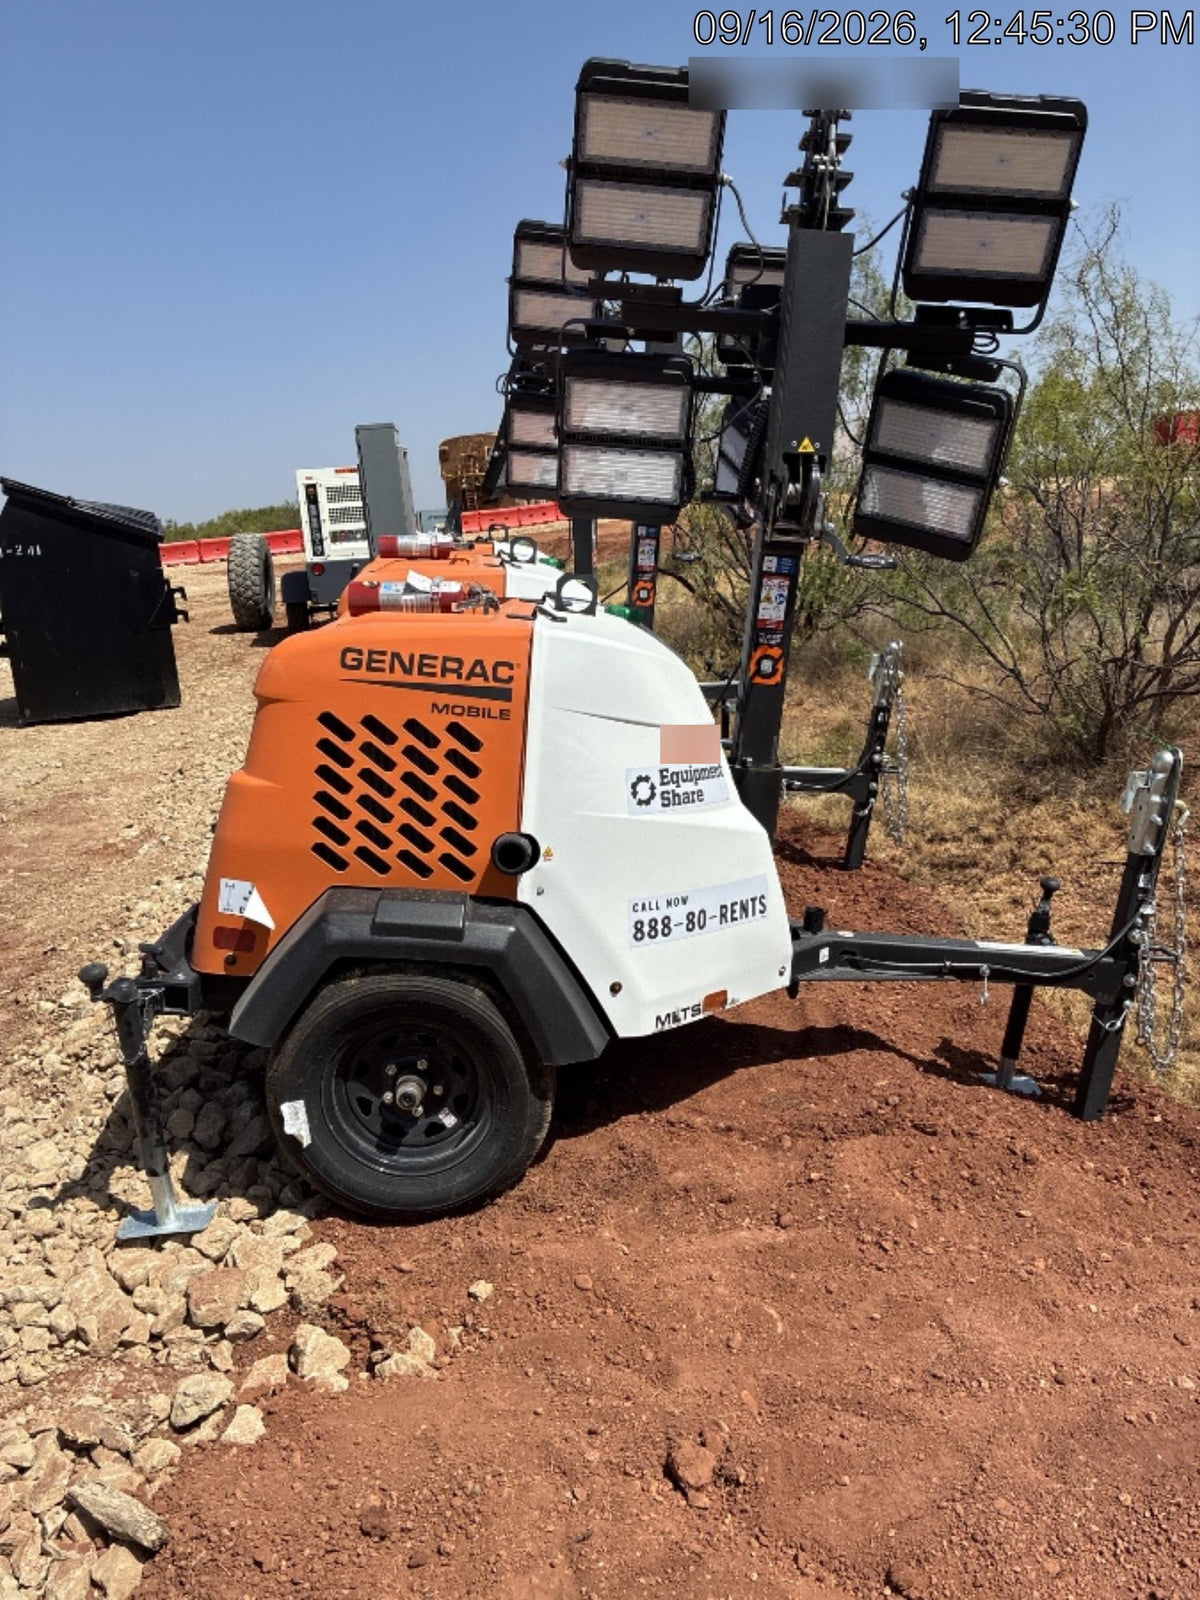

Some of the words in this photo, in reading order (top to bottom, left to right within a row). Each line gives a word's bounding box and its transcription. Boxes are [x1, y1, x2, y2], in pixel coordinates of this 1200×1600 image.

[340, 646, 515, 684] GENERAC
[431, 702, 511, 720] MOBILE
[659, 764, 724, 788] Equipment
[660, 788, 705, 808] Share
[632, 899, 661, 913] CALL
[666, 895, 690, 909] NOW
[632, 893, 767, 942] 888-80-RENTS
